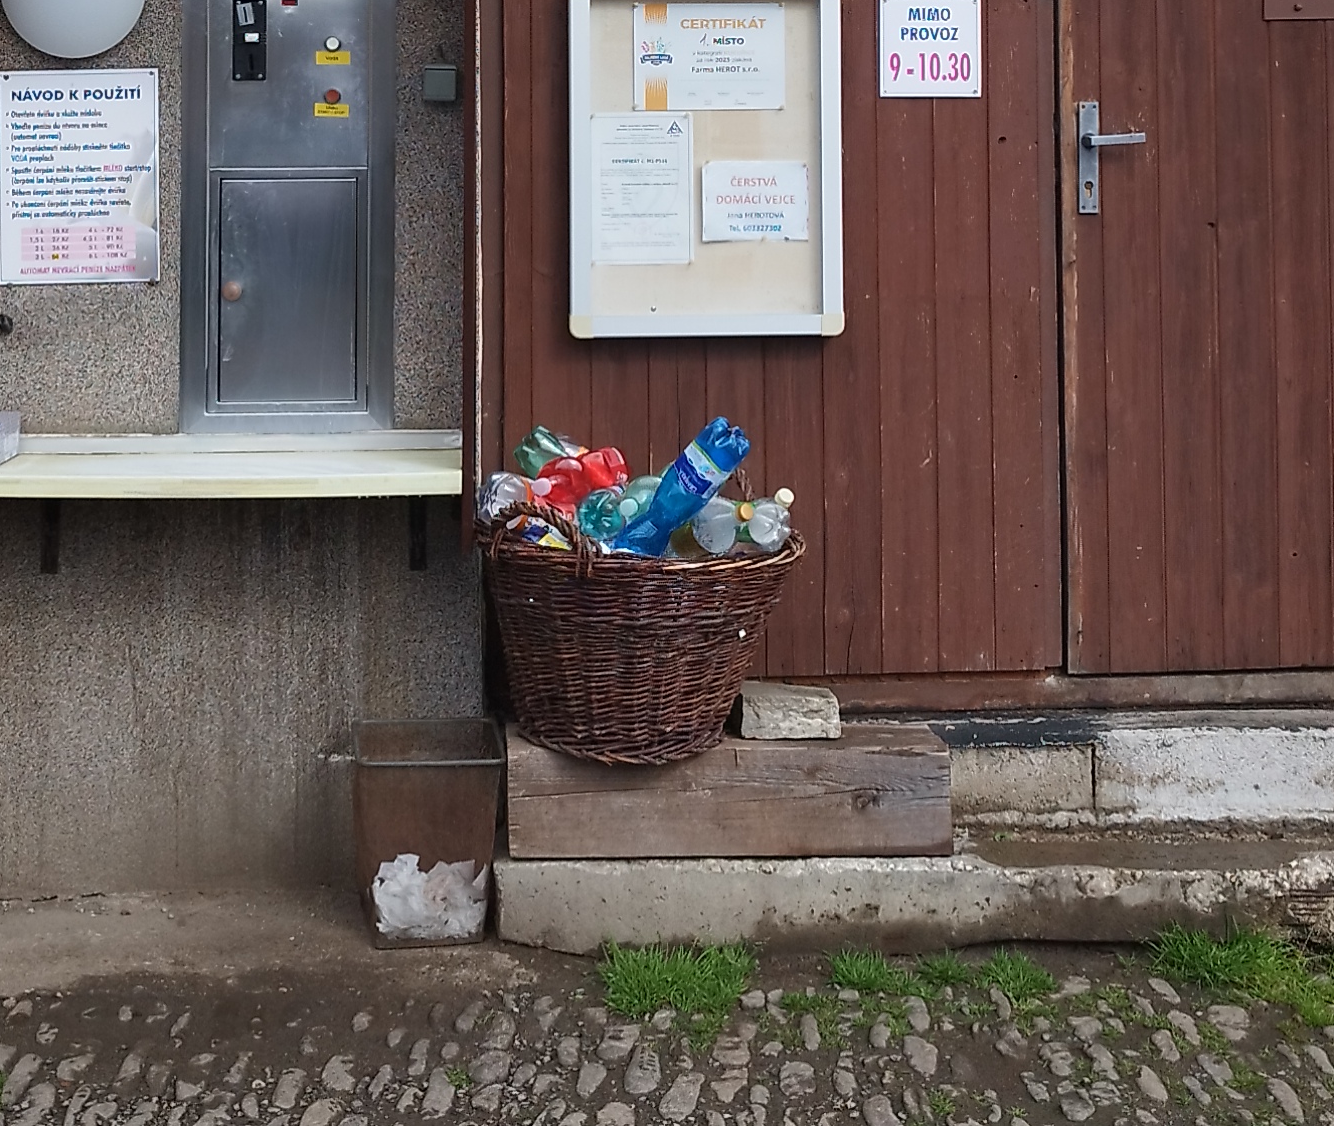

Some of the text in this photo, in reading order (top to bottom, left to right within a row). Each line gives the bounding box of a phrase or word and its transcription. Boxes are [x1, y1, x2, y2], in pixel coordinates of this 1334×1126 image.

[908, 7, 951, 22] MIMO
[680, 16, 766, 29] CERTIFIKÁT
[713, 36, 745, 45] MÍSTO
[900, 27, 959, 41] PROVOZ
[889, 52, 901, 82] 9
[11, 85, 141, 101] NÁVOD K POUŽITÍ
[730, 176, 777, 187] ČERSTVÁ
[716, 193, 795, 204] DOMÁCÍ VEJCE
